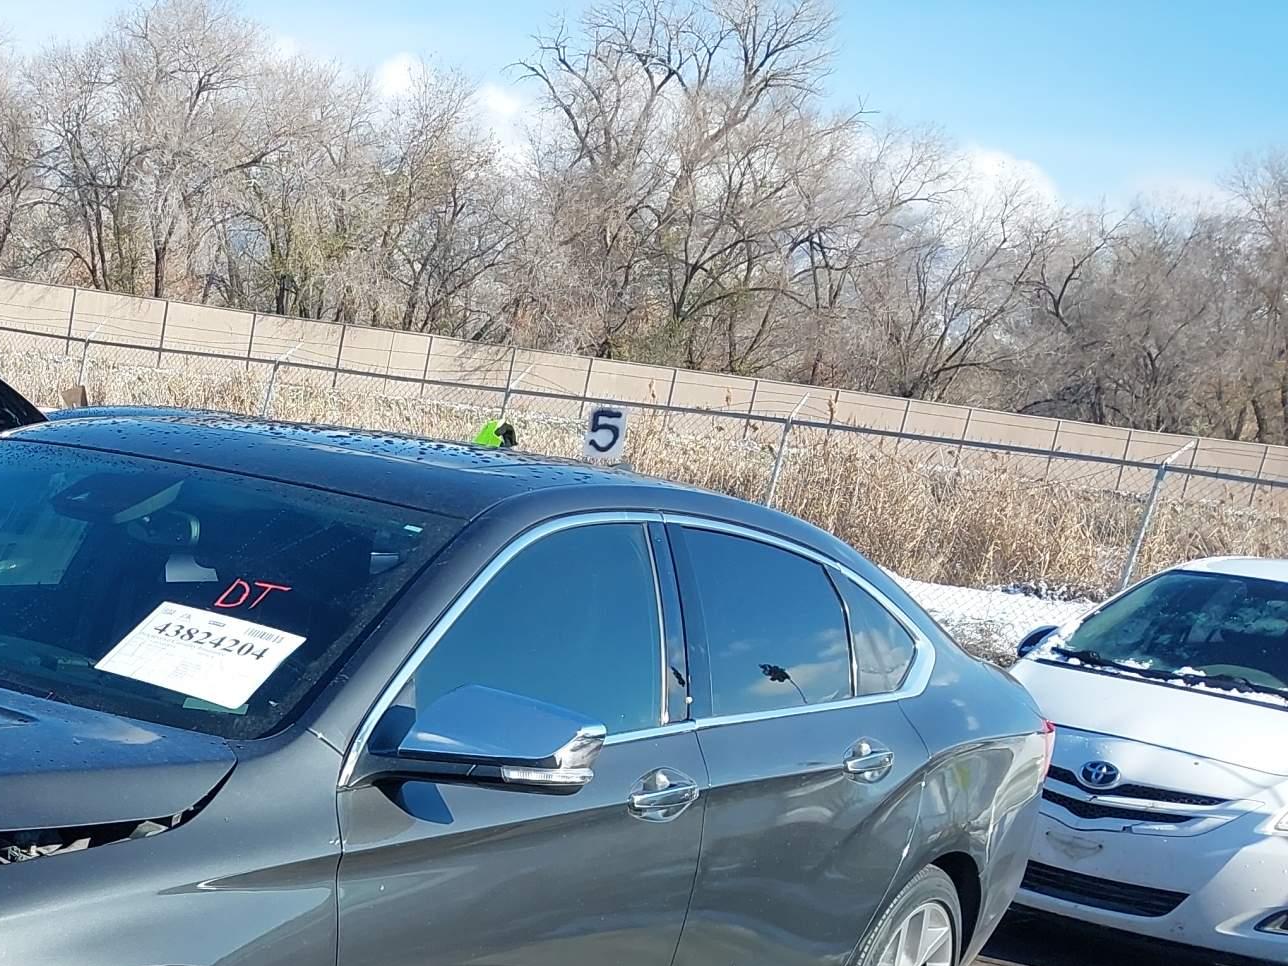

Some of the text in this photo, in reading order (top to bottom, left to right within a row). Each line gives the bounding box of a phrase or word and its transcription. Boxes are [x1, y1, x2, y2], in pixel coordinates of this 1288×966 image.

[588, 409, 622, 453] 5
[214, 578, 292, 609] DT
[153, 621, 270, 661] 43824204
